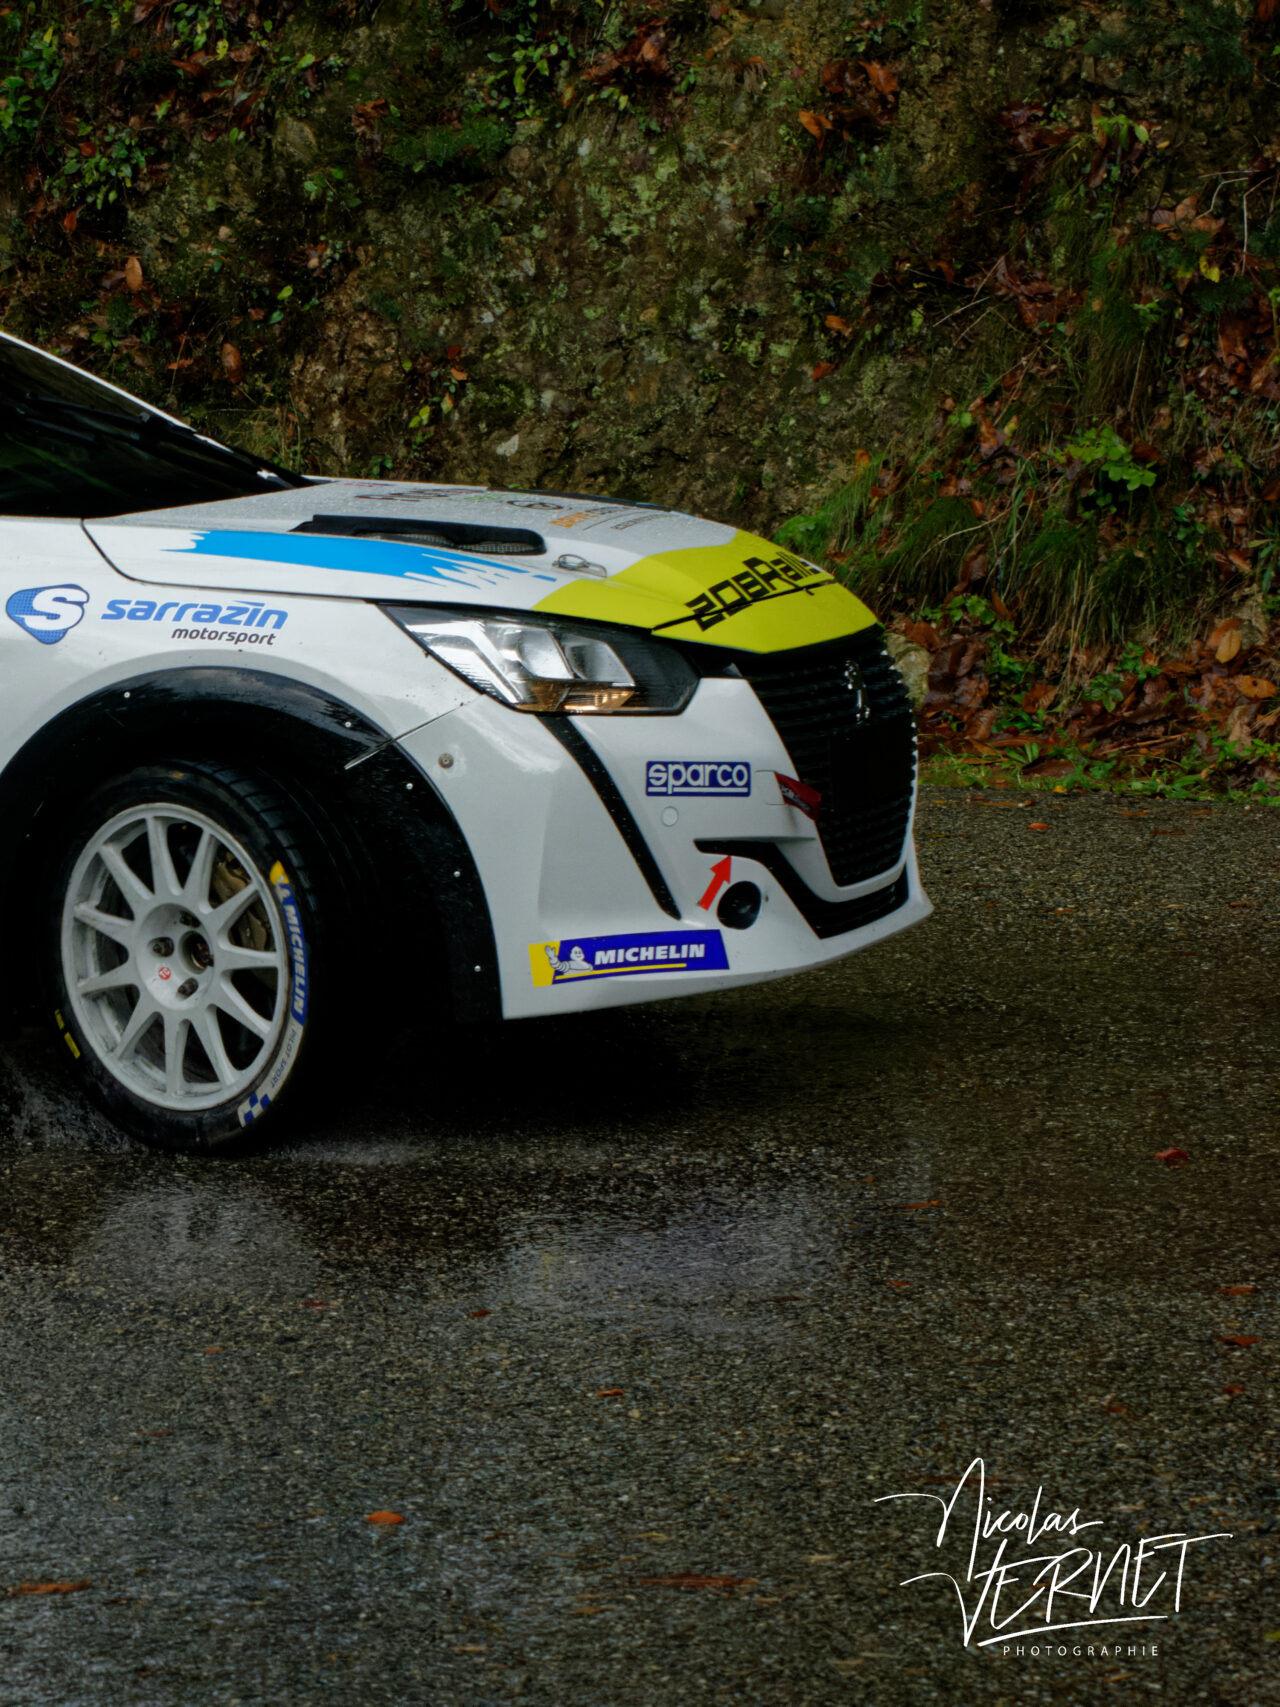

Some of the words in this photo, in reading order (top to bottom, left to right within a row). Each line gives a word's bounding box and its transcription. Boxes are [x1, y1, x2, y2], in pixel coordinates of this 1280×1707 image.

[100, 599, 289, 631] sarrazin
[171, 626, 277, 646] motorsport
[647, 764, 749, 794] sparco
[285, 903, 307, 1016] MICHELIN
[594, 943, 706, 966] MICHELIN
